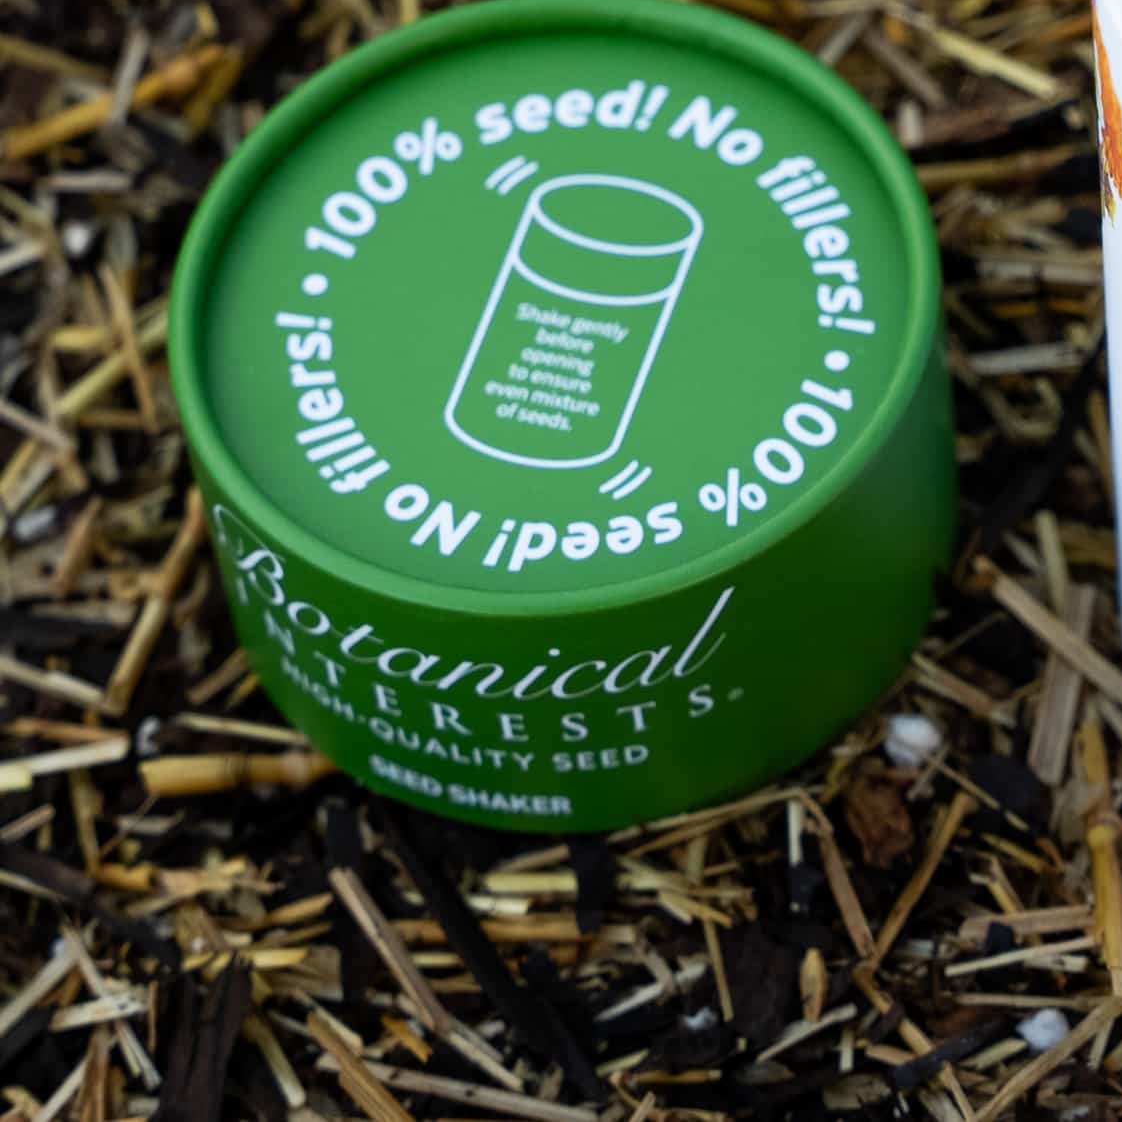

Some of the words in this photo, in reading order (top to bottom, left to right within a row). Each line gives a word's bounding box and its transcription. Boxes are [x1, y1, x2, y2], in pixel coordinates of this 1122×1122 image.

[304, 116, 464, 260] 100%
[475, 79, 669, 146] seed!
[666, 95, 764, 166] No
[755, 155, 876, 335] fillers!
[516, 302, 571, 328] Shake
[570, 317, 629, 344] gently
[535, 327, 594, 354] before
[508, 363, 529, 381] to
[530, 370, 593, 395] ensure
[520, 347, 595, 378] opening
[275, 311, 391, 494] fillers!
[484, 380, 529, 402] even
[530, 389, 601, 417] mixture
[496, 402, 518, 419] of
[516, 408, 572, 431] seeds.
[698, 379, 855, 527] 100%
[384, 483, 482, 557] No
[481, 501, 684, 573] seed!
[213, 504, 736, 700] Botanical
[281, 654, 536, 773] HIGH-QUALITY
[552, 744, 650, 773] SEED
[368, 754, 443, 797] SEED
[447, 782, 573, 816] SHAKER
